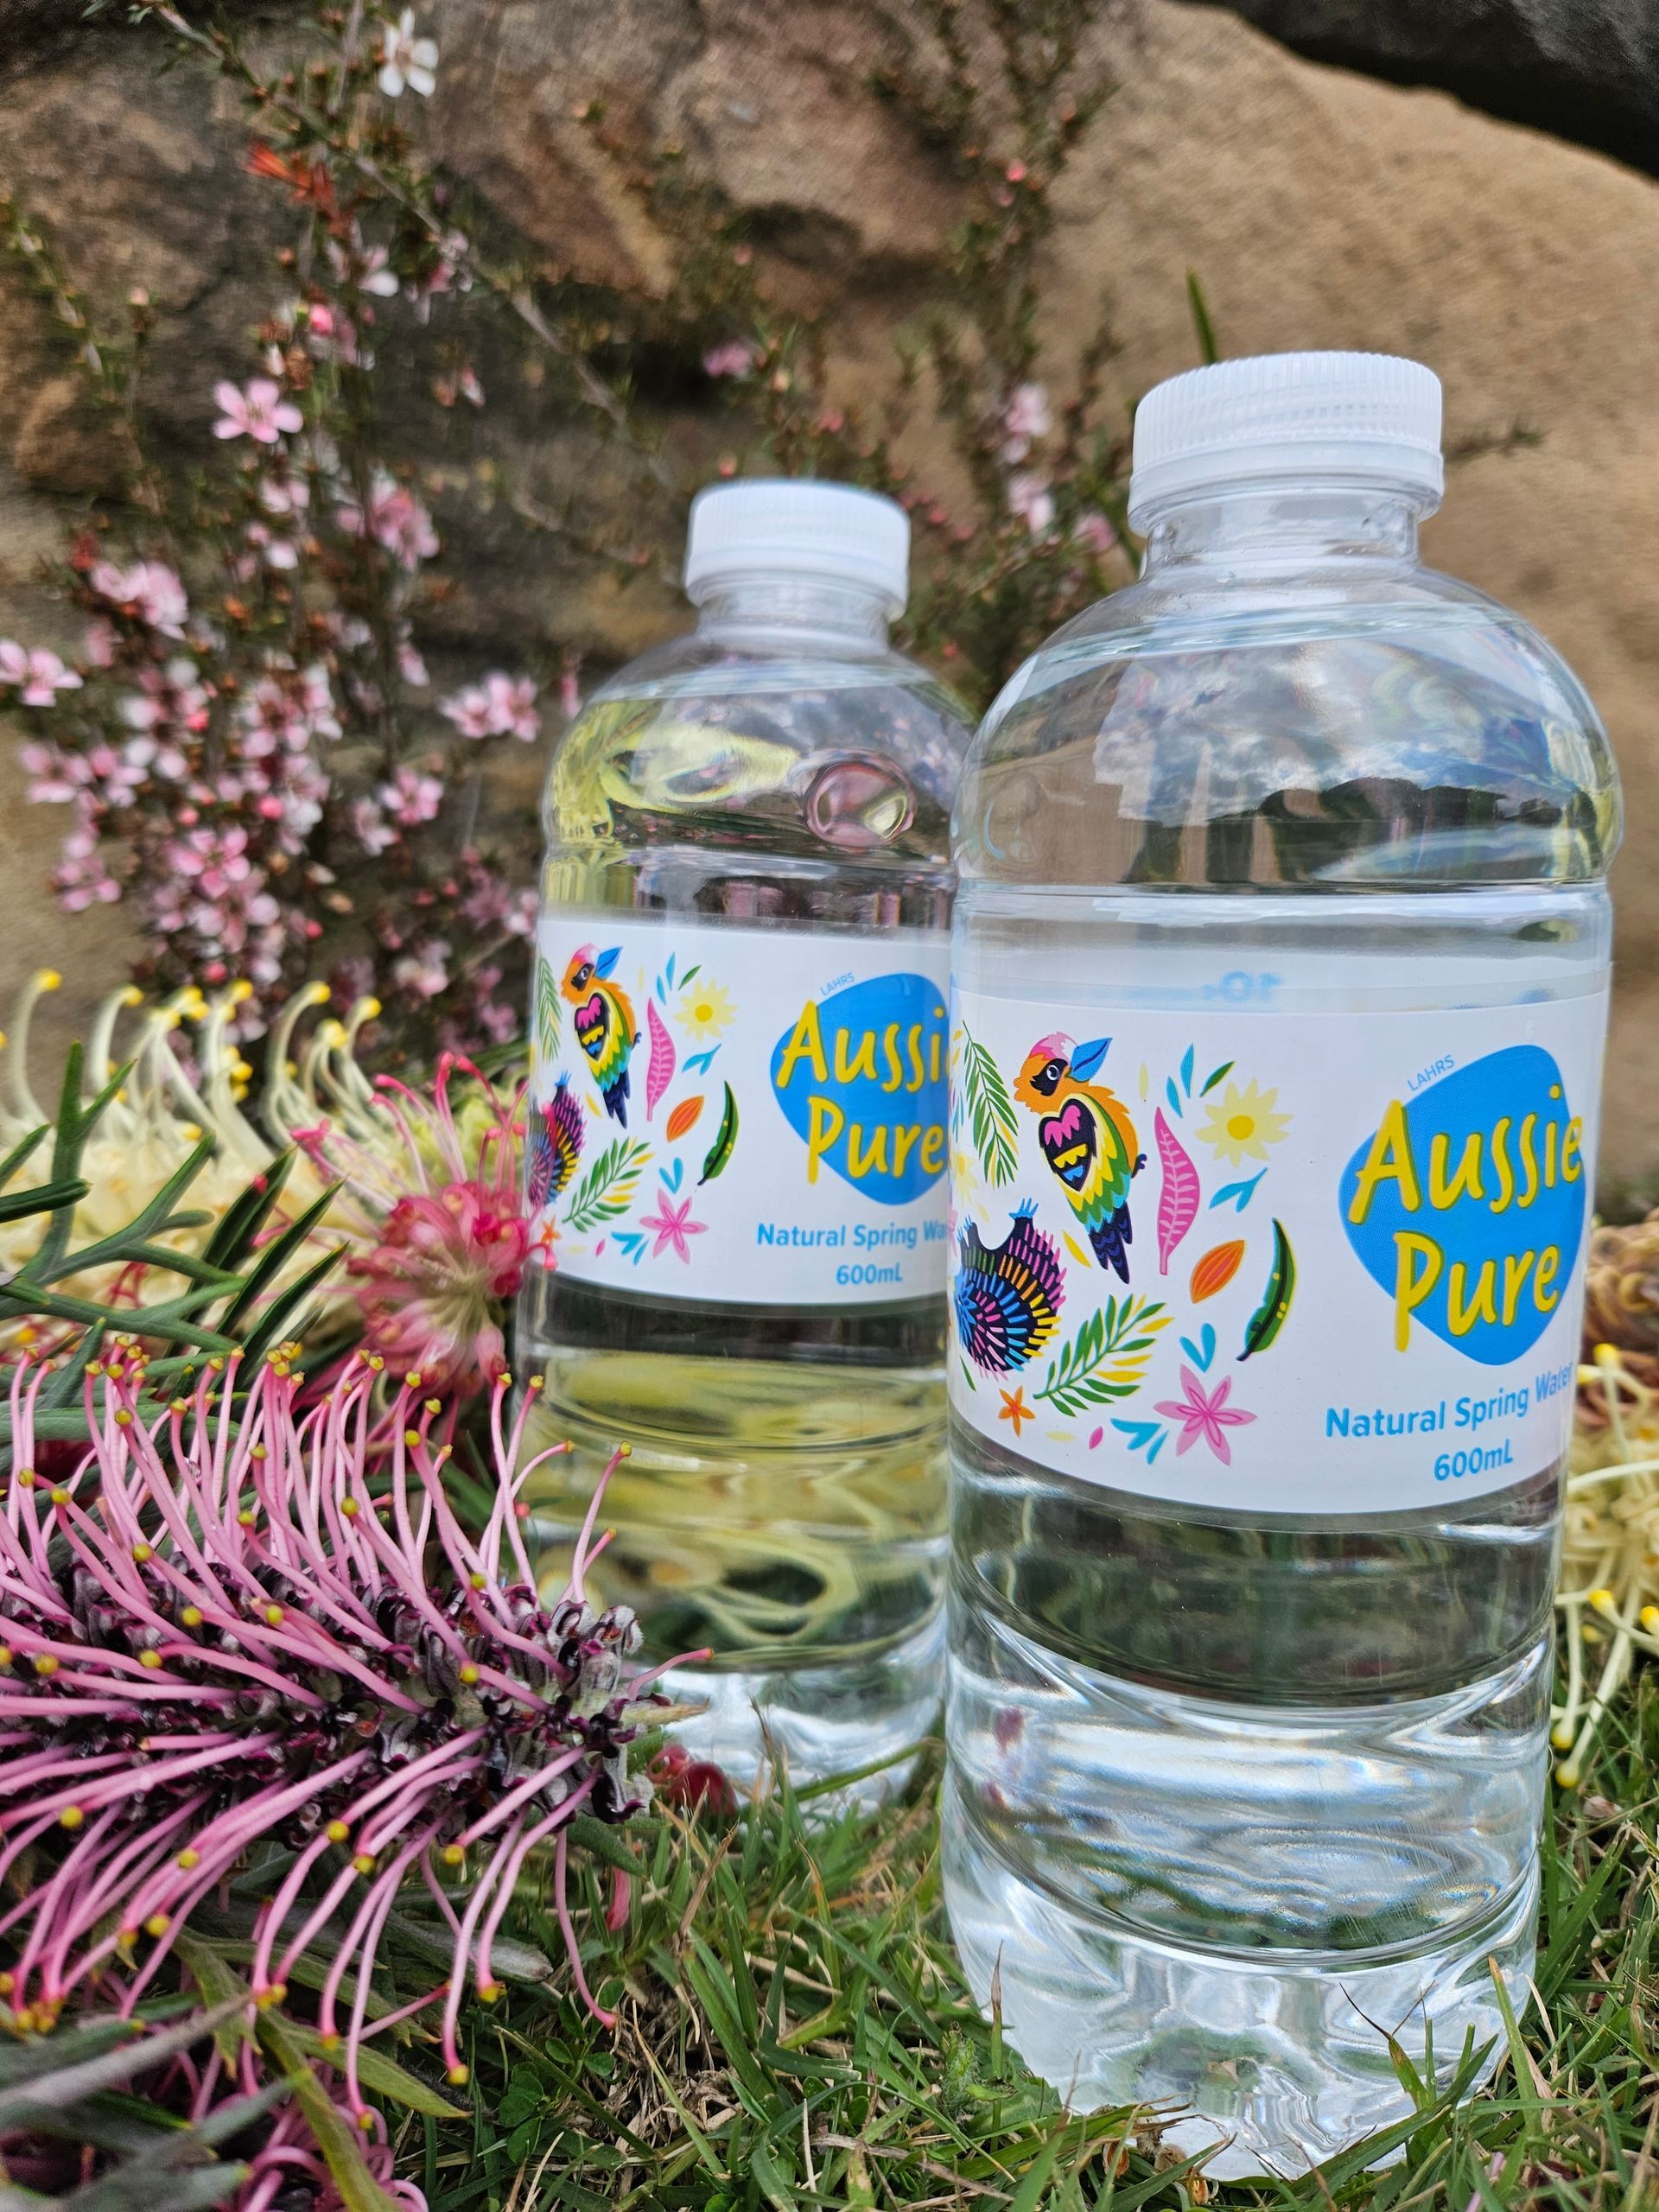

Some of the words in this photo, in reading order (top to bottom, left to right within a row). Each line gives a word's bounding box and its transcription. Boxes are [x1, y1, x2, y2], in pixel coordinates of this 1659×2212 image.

[820, 972, 855, 997] LAHRS
[777, 1000, 949, 1092] Aussi
[1407, 1053, 1455, 1092] LAHRS
[807, 1095, 945, 1185] Pure
[1347, 1084, 1583, 1225] Aussie
[757, 1223, 846, 1247] Natural
[853, 1224, 917, 1251] Spring
[836, 1262, 902, 1286] 600mL
[1393, 1230, 1560, 1353] Pure
[1325, 1400, 1446, 1438] Natural
[1454, 1385, 1529, 1431] Spring
[1433, 1438, 1513, 1481] 600mL
